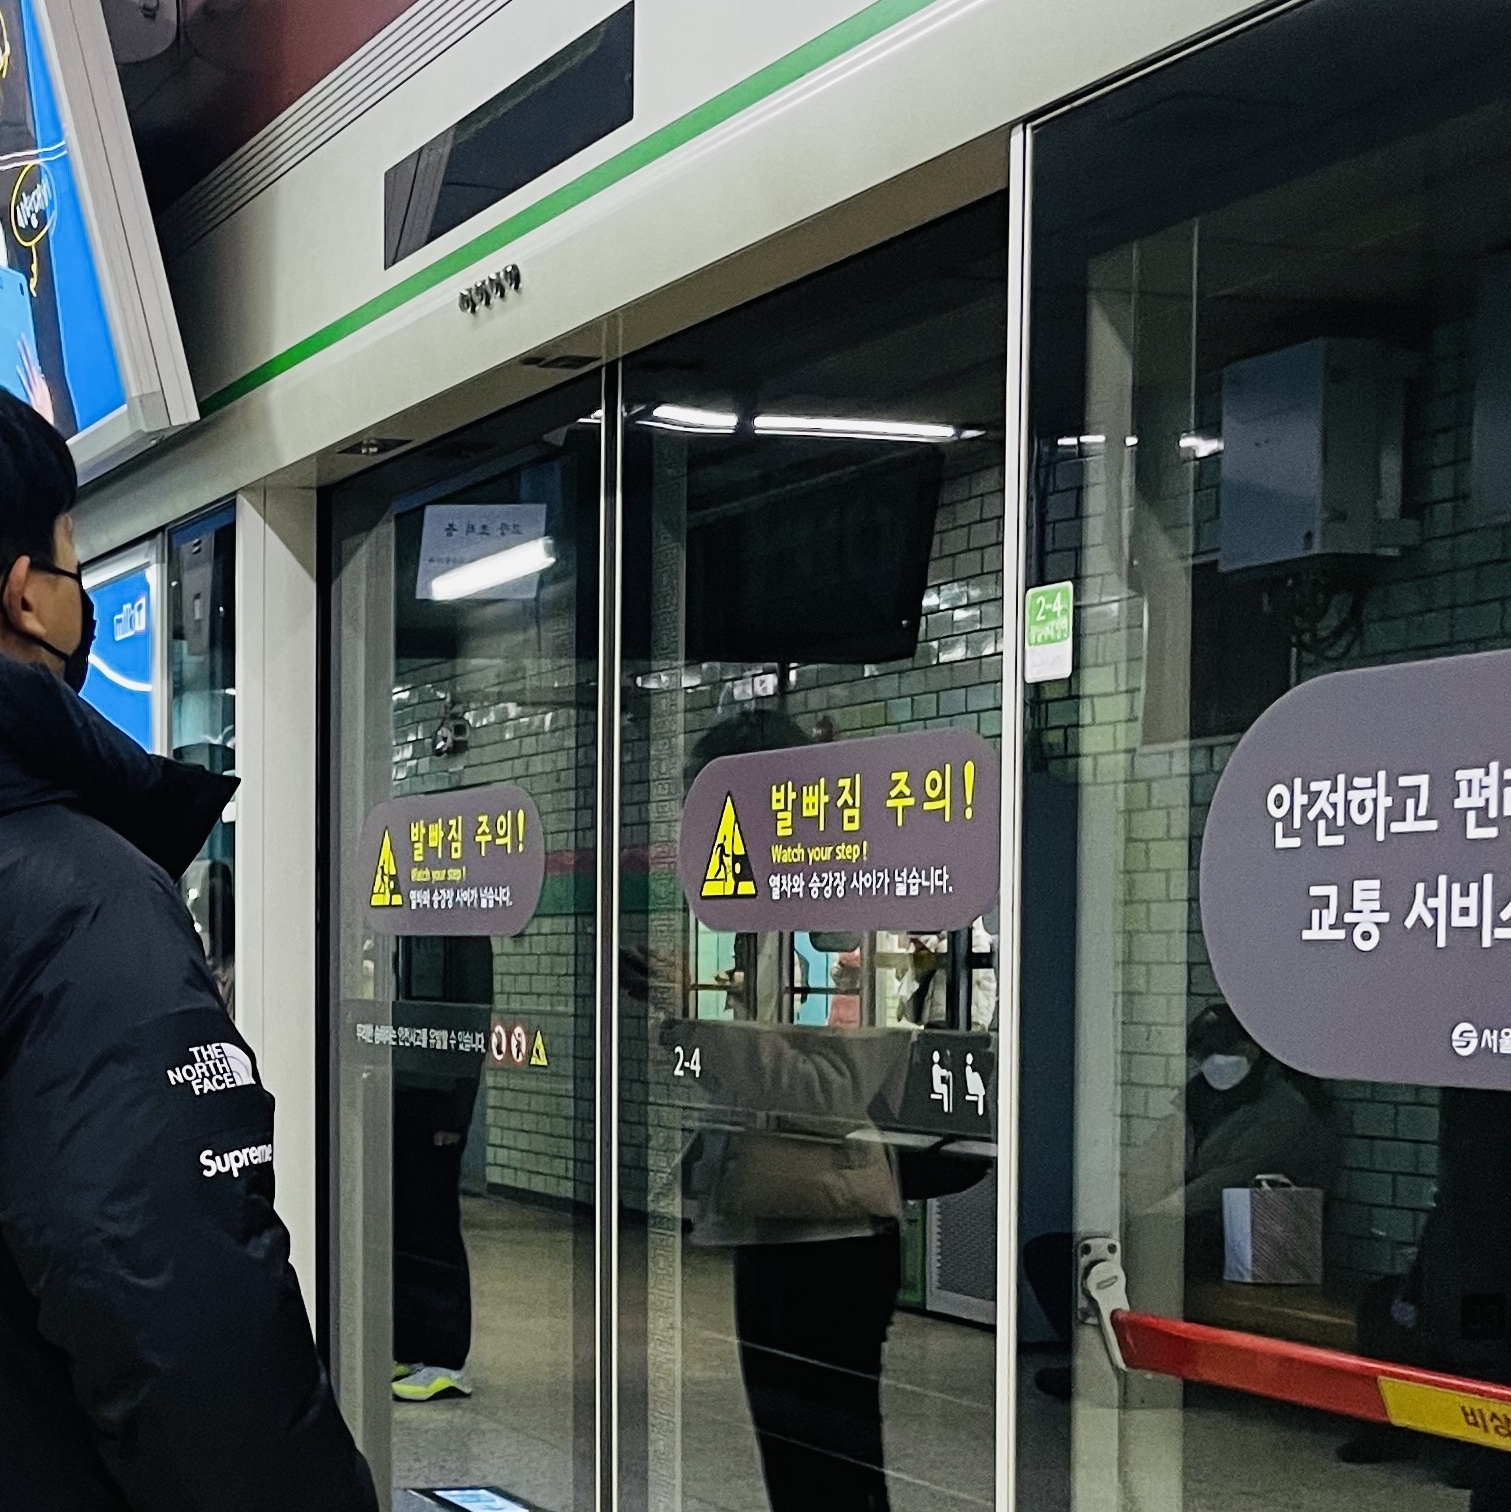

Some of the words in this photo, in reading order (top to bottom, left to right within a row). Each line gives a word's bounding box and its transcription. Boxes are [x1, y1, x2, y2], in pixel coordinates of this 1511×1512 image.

[1036, 591, 1063, 621] 2-4
[771, 773, 861, 837] 발빠짐
[886, 760, 976, 827] 주의!
[1266, 770, 1438, 849] 안전하고
[410, 815, 463, 862] 발빠짐
[474, 809, 525, 856] 주의!
[771, 844, 805, 864] Watch
[807, 845, 833, 866] your
[432, 888, 454, 909] 승강장
[455, 887, 478, 909] 사이가
[479, 886, 513, 909] 넓습니다.
[769, 872, 805, 901] 열차와
[808, 870, 846, 899] 승강장
[850, 869, 889, 896] 사이가
[894, 866, 953, 896] 넓습니다.
[1301, 879, 1391, 952] 교통
[188, 1043, 225, 1063] THE
[449, 1029, 457, 1051] 수
[166, 1057, 231, 1086] NORTH
[673, 1046, 702, 1078] 2-4
[191, 1073, 237, 1096] FACE
